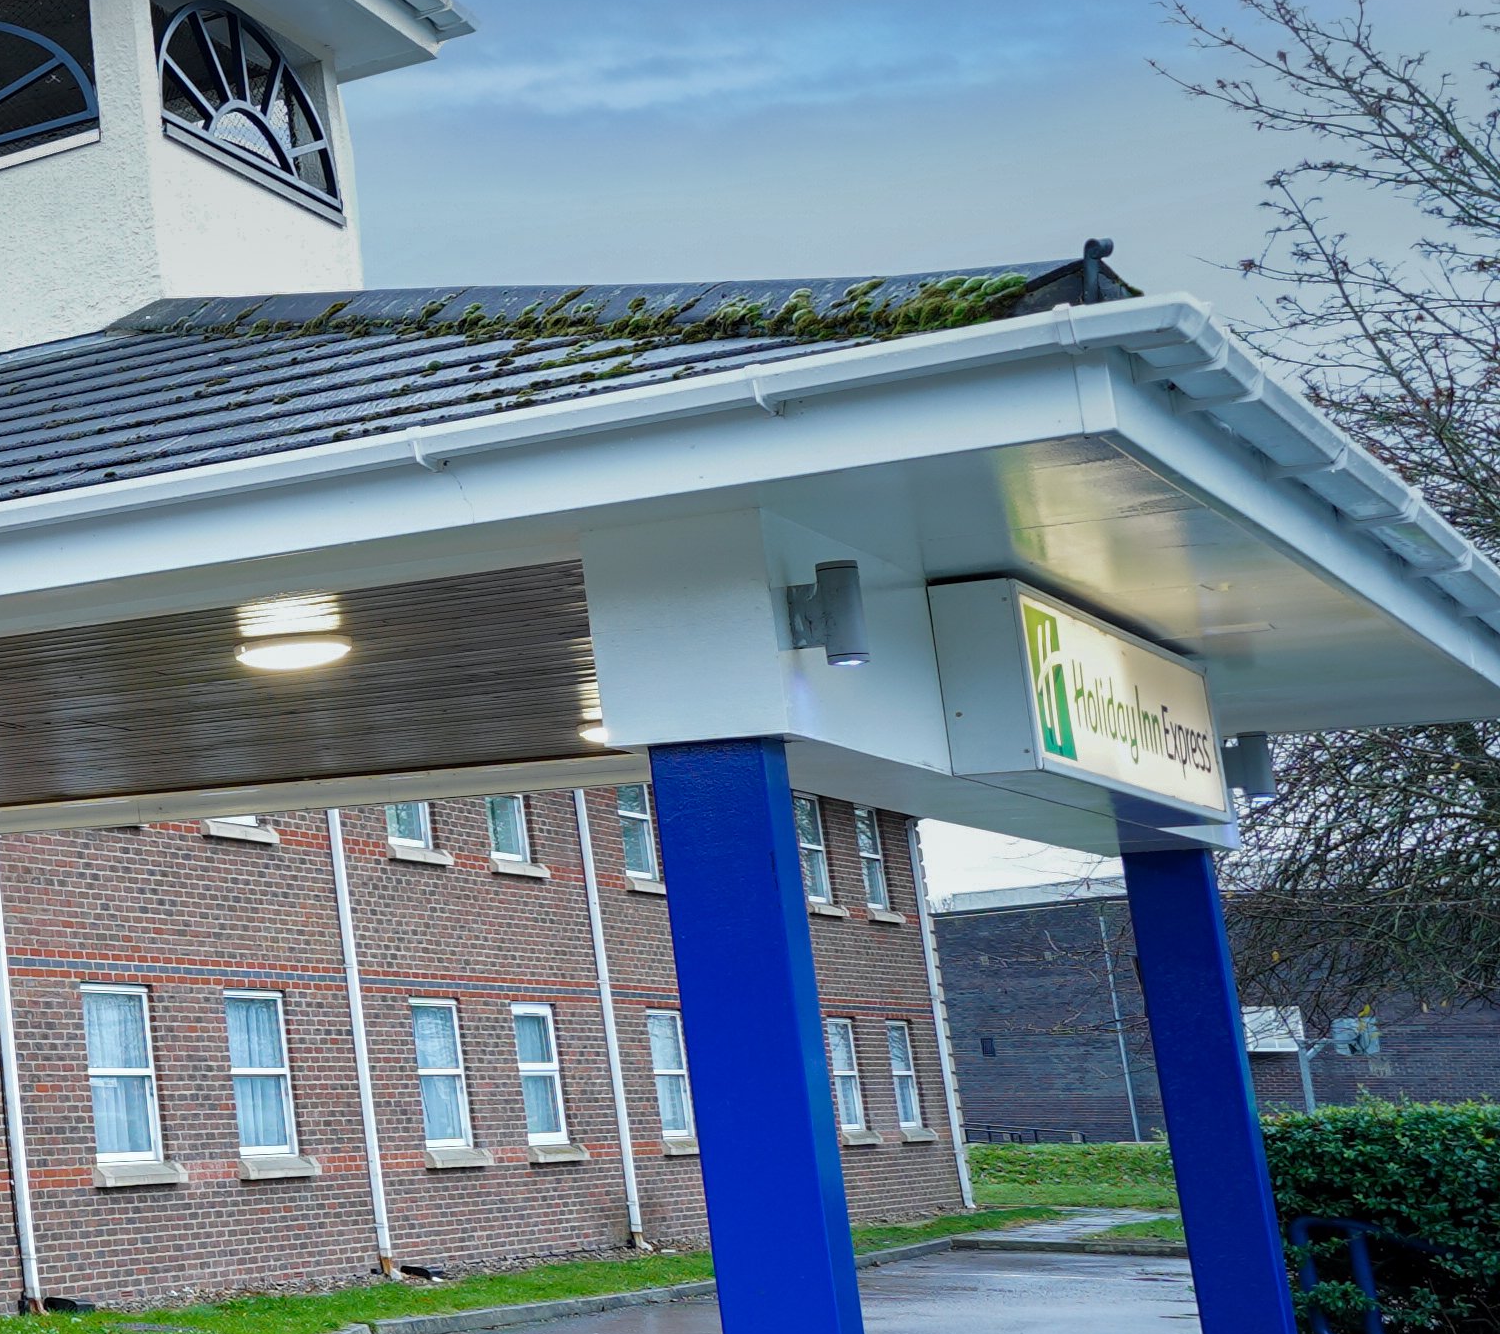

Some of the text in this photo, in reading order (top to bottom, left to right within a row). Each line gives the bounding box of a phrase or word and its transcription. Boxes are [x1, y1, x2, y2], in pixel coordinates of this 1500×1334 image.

[1071, 659, 1212, 779] Holiday Inn Express
